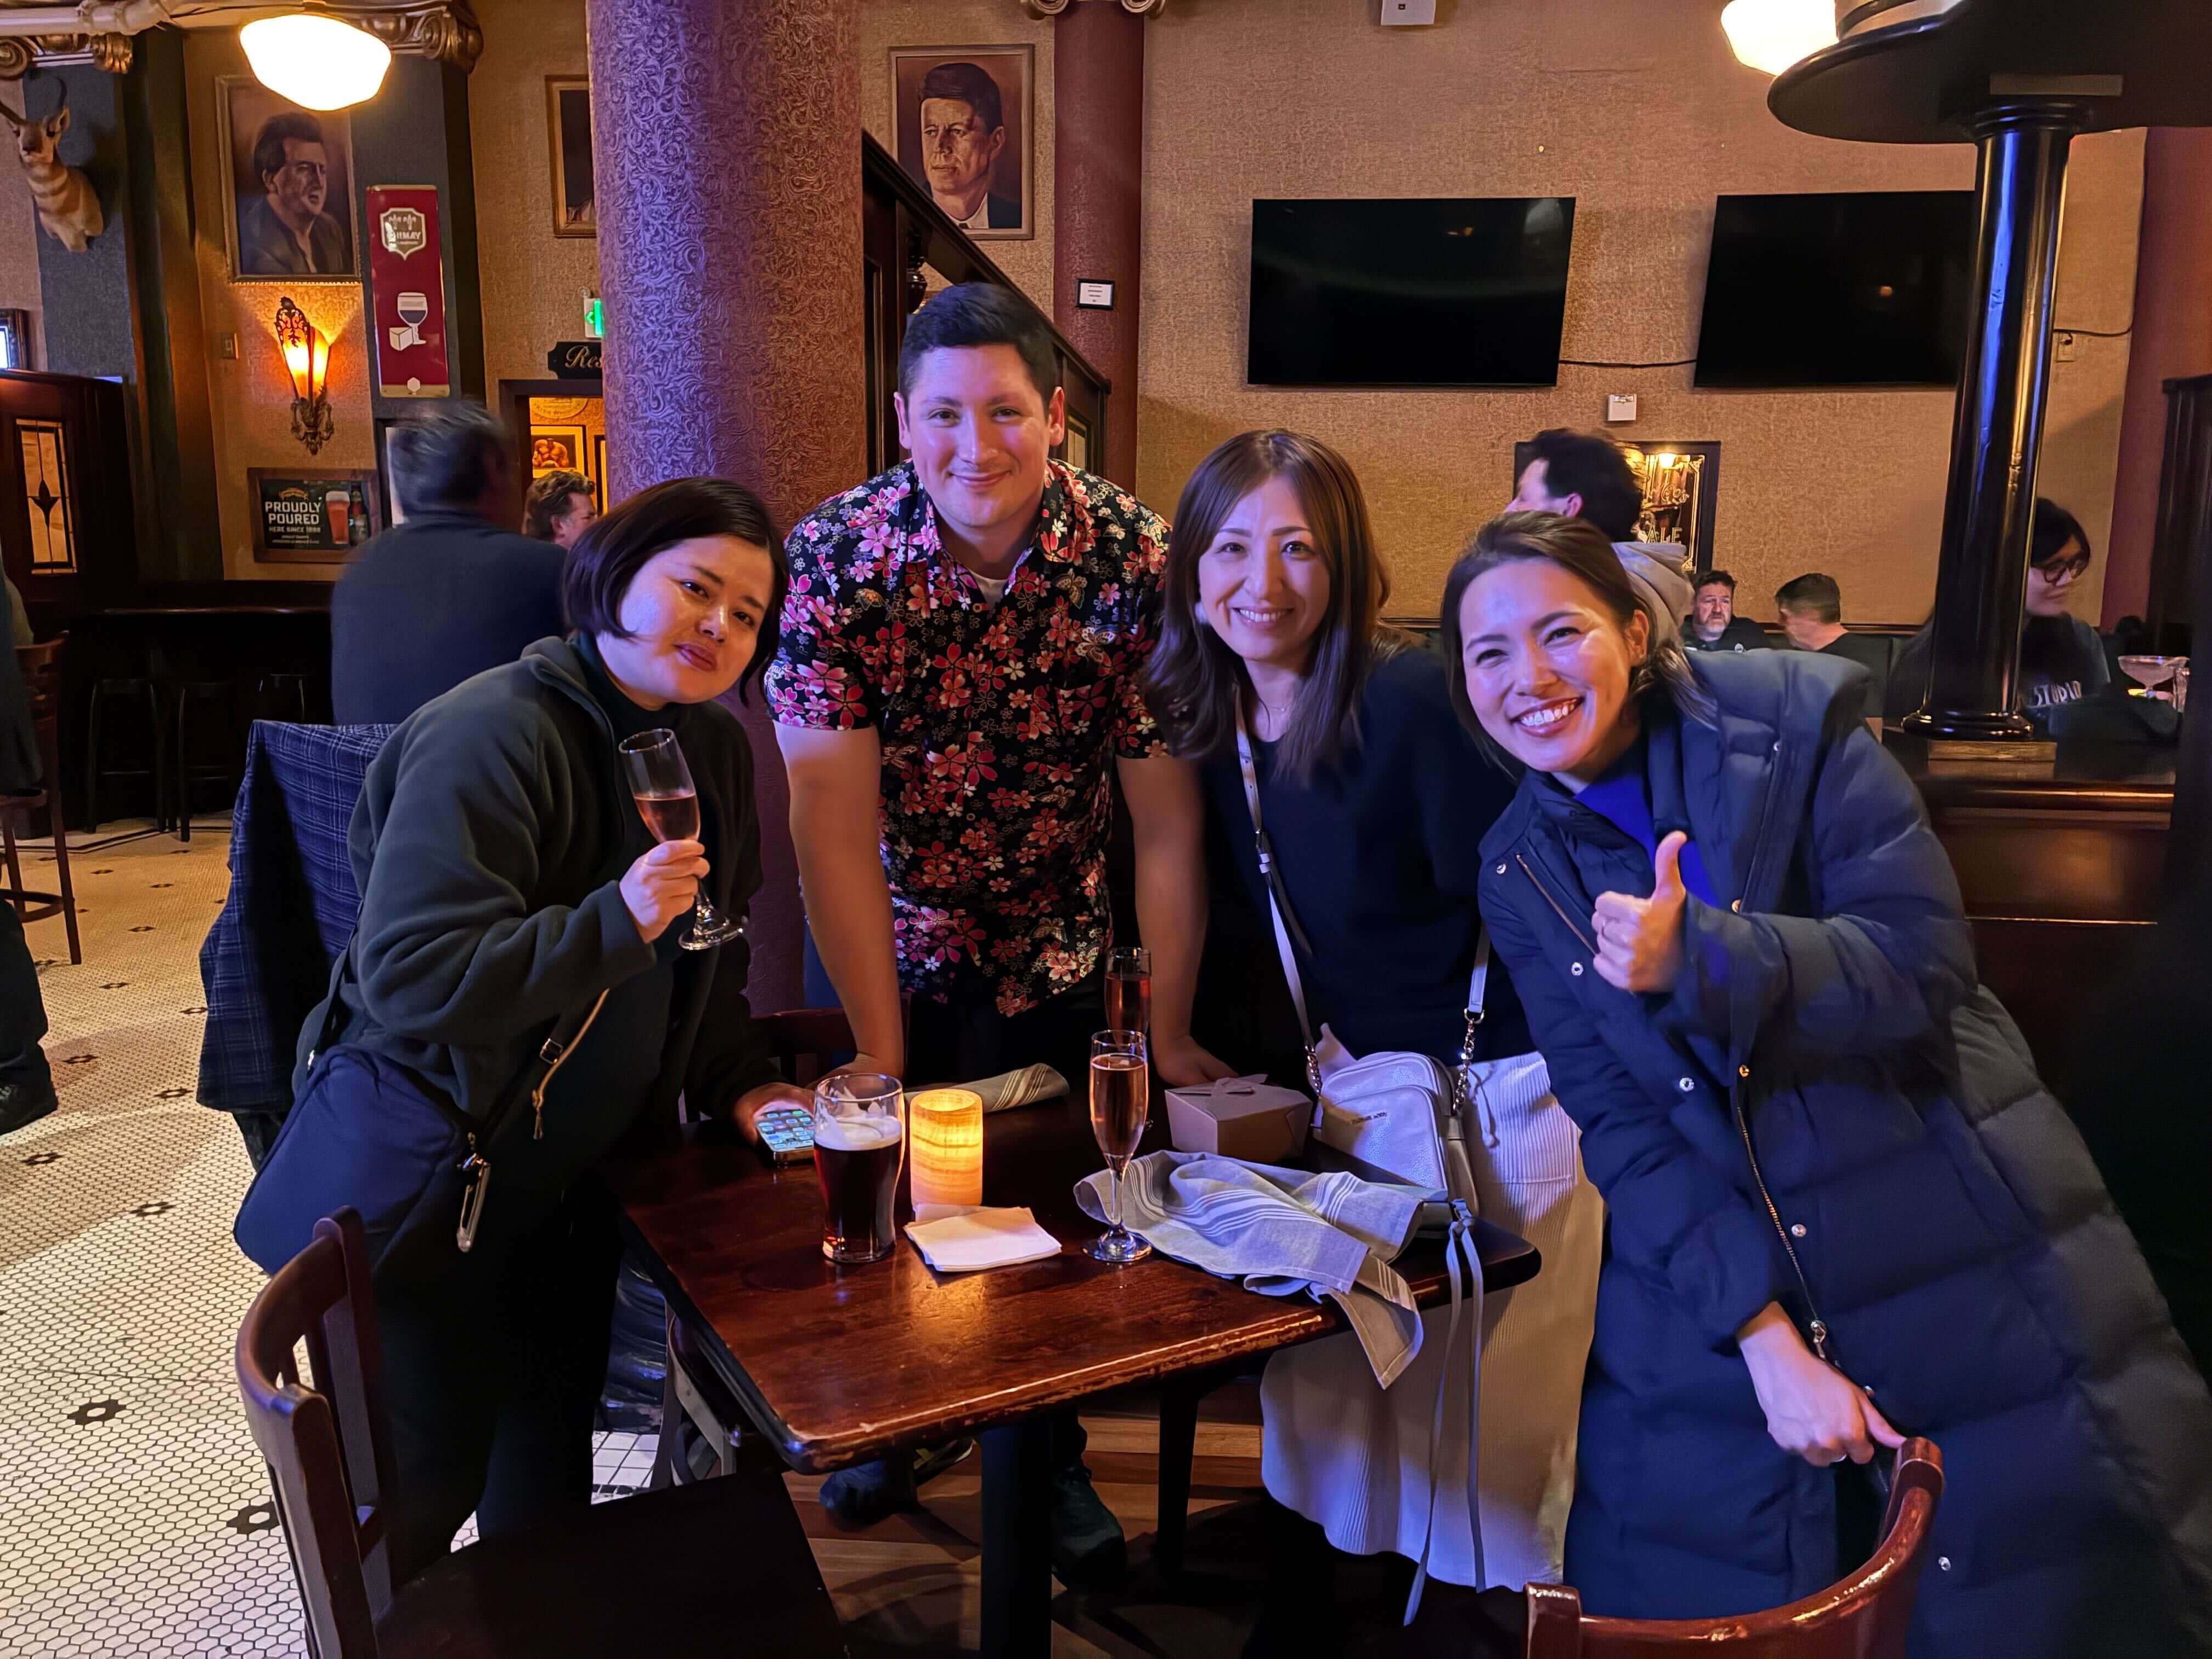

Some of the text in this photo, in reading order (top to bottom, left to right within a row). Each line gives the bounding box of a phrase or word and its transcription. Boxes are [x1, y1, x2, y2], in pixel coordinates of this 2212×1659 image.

[265, 501, 321, 513] PROUDLY
[268, 514, 319, 525] POURED
[1646, 526, 1683, 544] ALE
